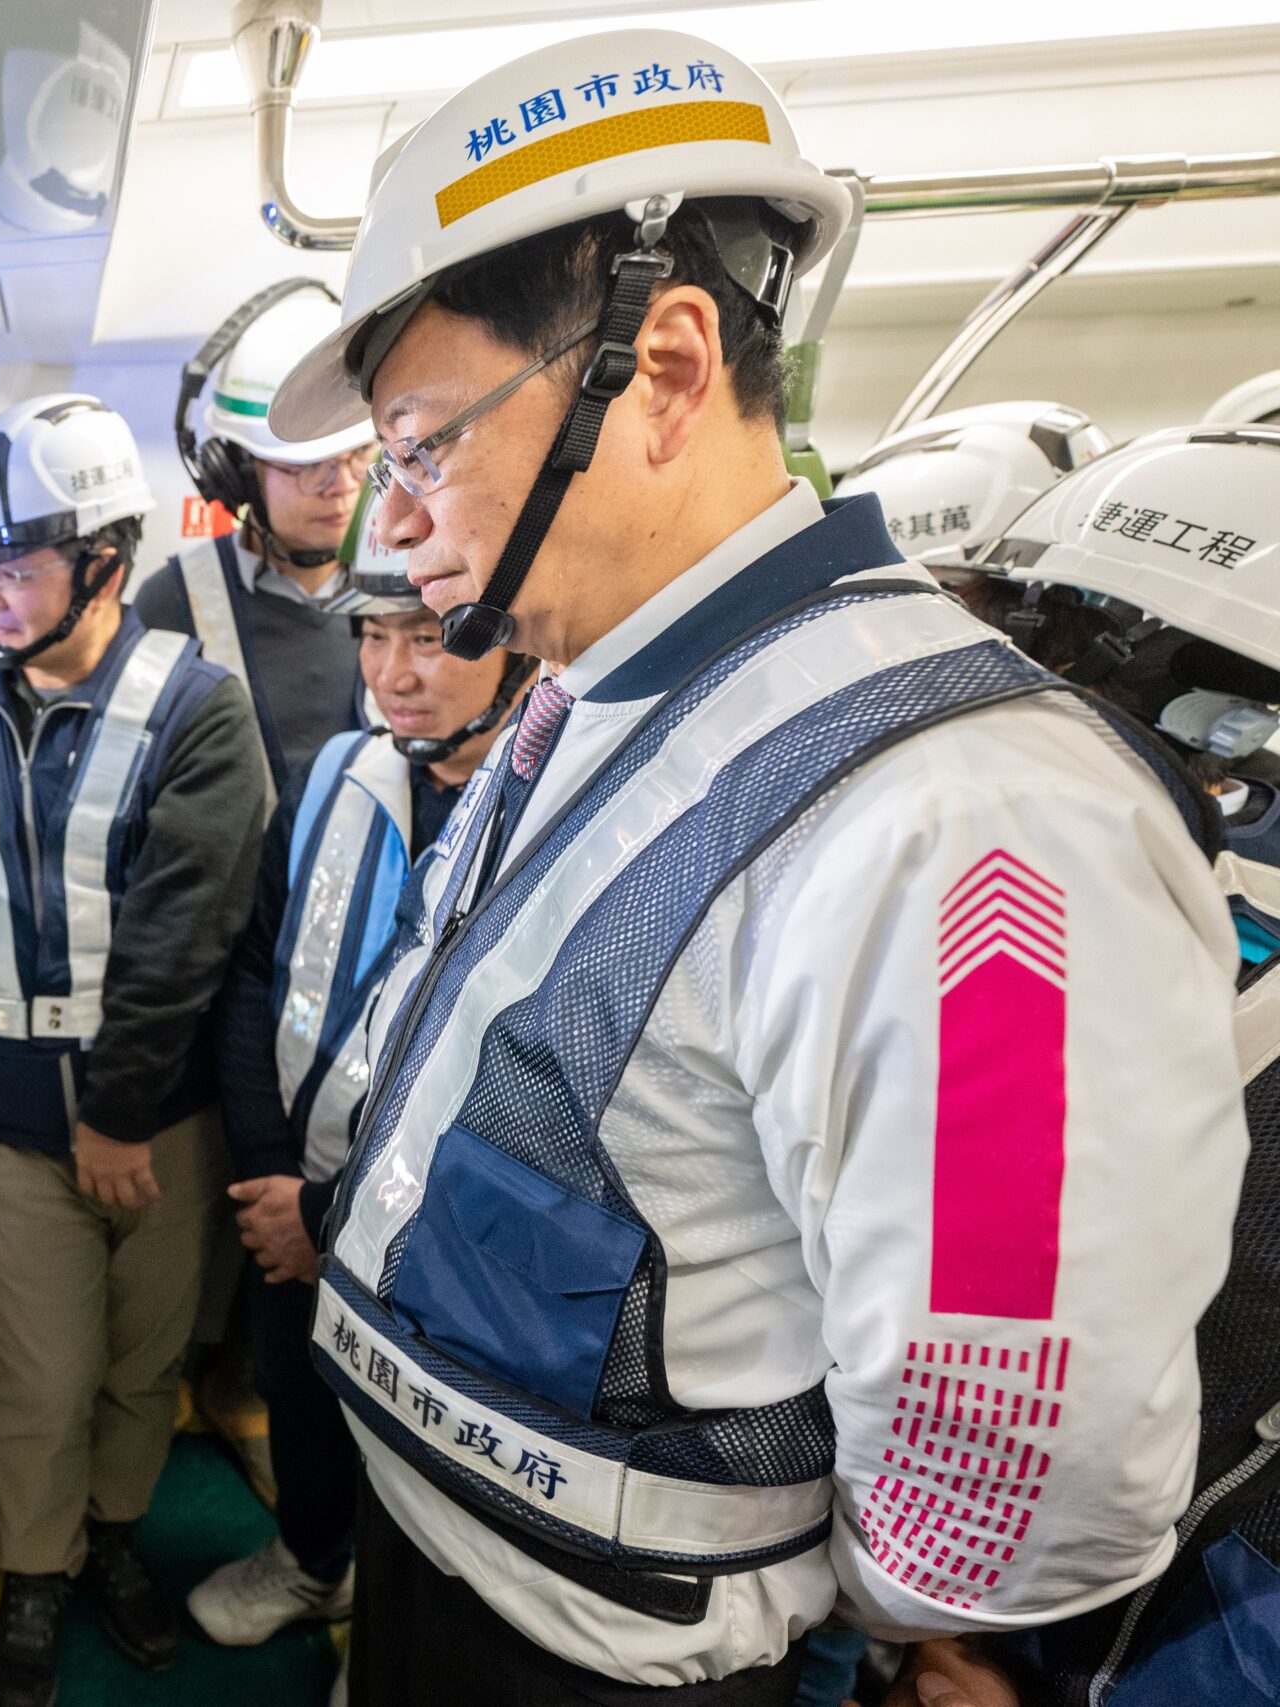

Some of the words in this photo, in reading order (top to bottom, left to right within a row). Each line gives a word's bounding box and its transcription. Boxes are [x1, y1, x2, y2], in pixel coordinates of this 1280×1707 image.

[463, 59, 725, 162] 桃園市政府
[1077, 500, 1258, 571] 捷運工程
[332, 1313, 568, 1501] 桃園市政府
